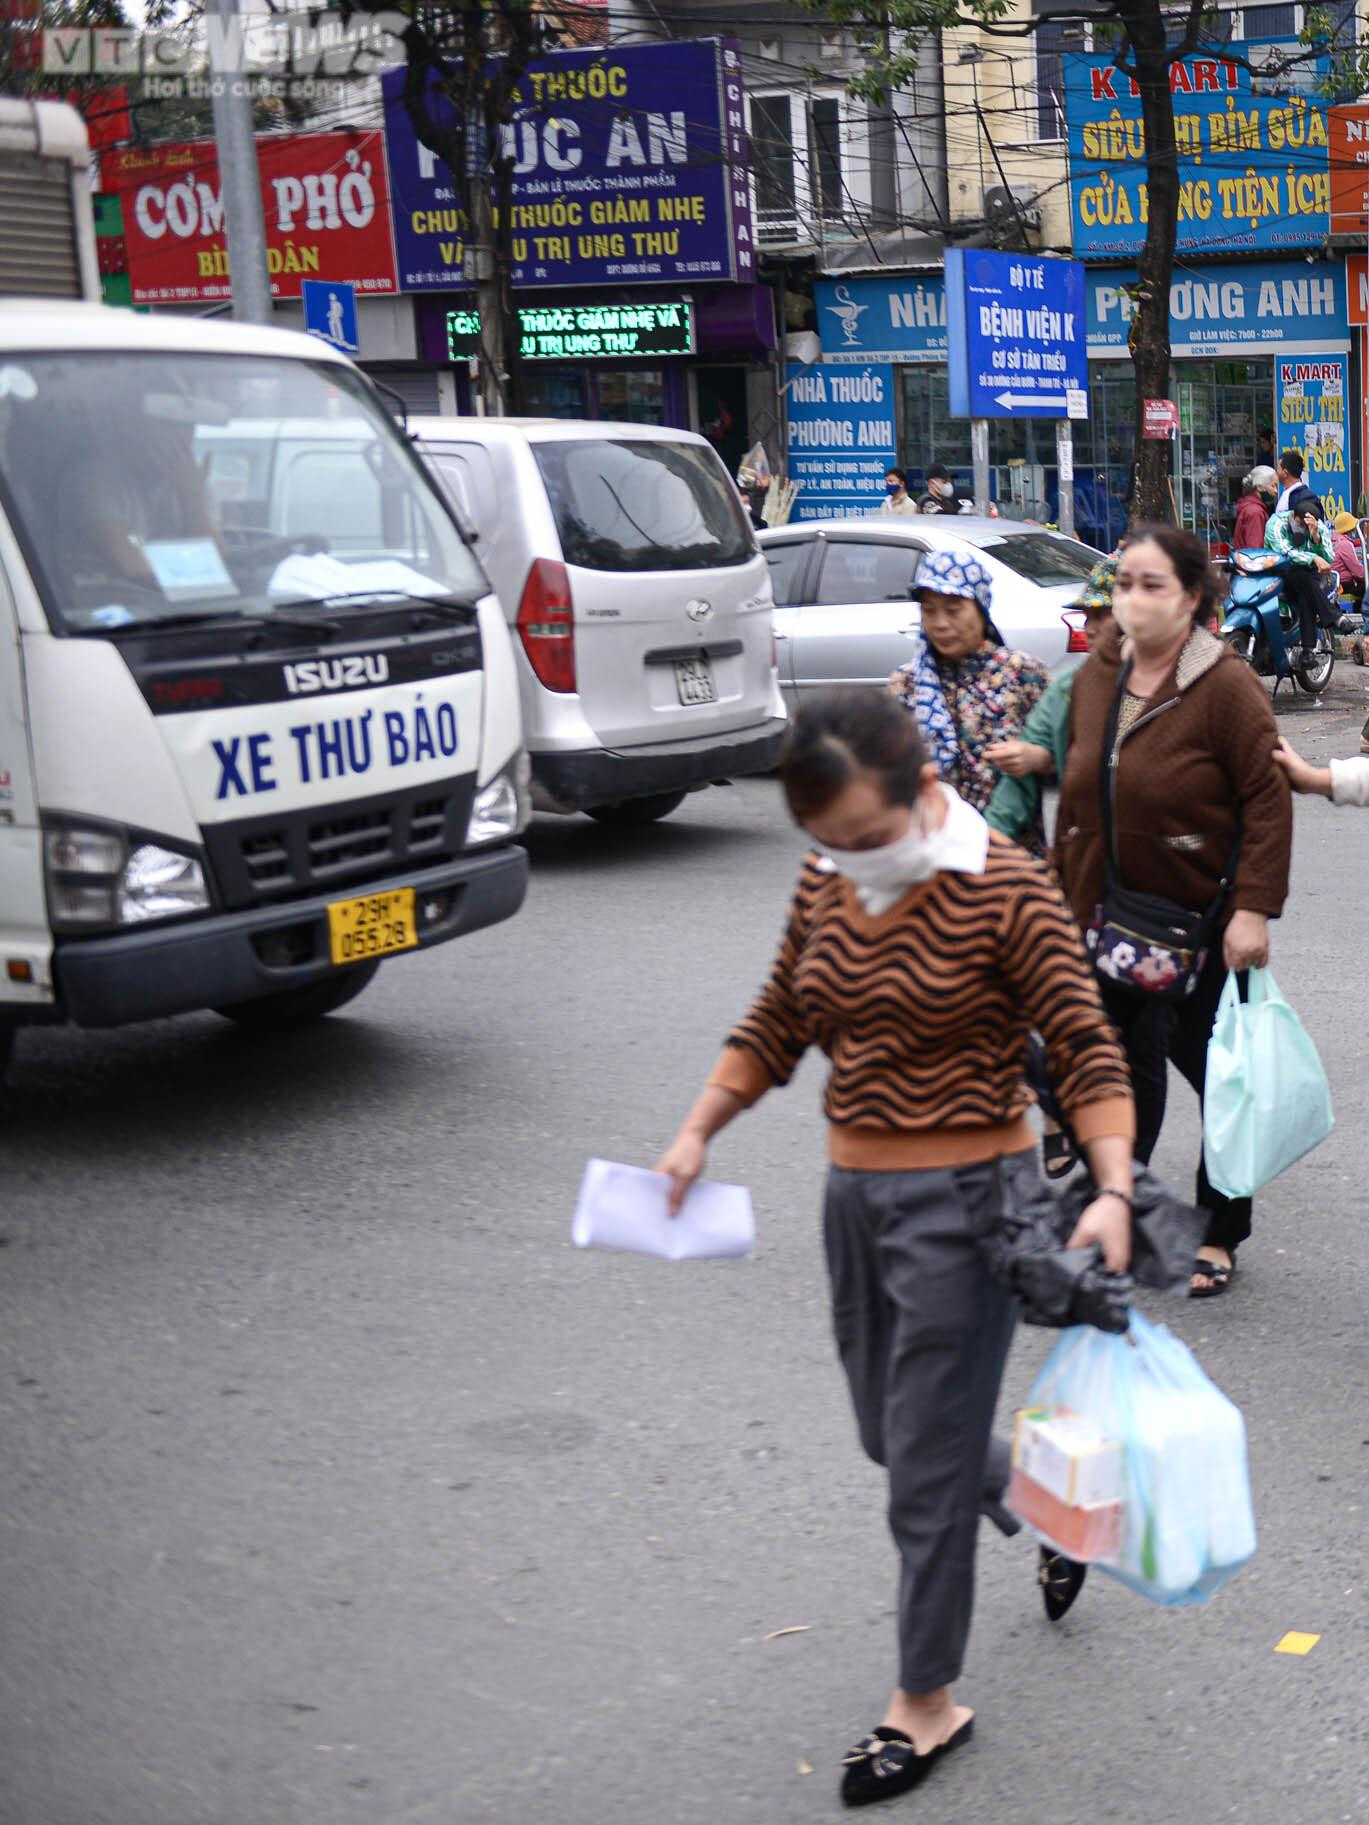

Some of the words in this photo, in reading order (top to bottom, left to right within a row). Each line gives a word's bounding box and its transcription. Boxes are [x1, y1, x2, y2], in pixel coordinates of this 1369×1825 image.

[1090, 65, 1118, 100] K
[606, 111, 688, 166] AN
[1082, 108, 1145, 160] SIÊU
[271, 149, 374, 232] PHỞ
[1079, 169, 1133, 226] CỬA
[1217, 167, 1281, 229] TIỆN
[589, 193, 650, 225] GIẢM
[657, 196, 705, 225] NHẸ
[267, 241, 320, 273] DÂN
[534, 236, 571, 264] TRỊ
[578, 233, 626, 259] UNG
[632, 228, 680, 256] THƯ
[1010, 263, 1023, 291] BỘ
[1025, 268, 1031, 288] Y
[1033, 264, 1045, 290] TẾ
[1257, 278, 1335, 318] ANH
[979, 300, 1024, 343] BỆNH
[1026, 305, 1061, 346] VIỆN
[1064, 313, 1075, 342] K
[1022, 348, 1041, 370] TÂN
[1281, 363, 1293, 381] K
[1296, 363, 1341, 381] MART
[792, 371, 827, 403] NHÀ
[837, 368, 884, 403] THUỐC
[788, 419, 853, 447] PHƯƠNG
[857, 420, 892, 447] ANH
[284, 654, 389, 693] ISUZU
[212, 732, 277, 800] XE
[290, 708, 374, 783] THƯ
[385, 692, 459, 768] BÁO
